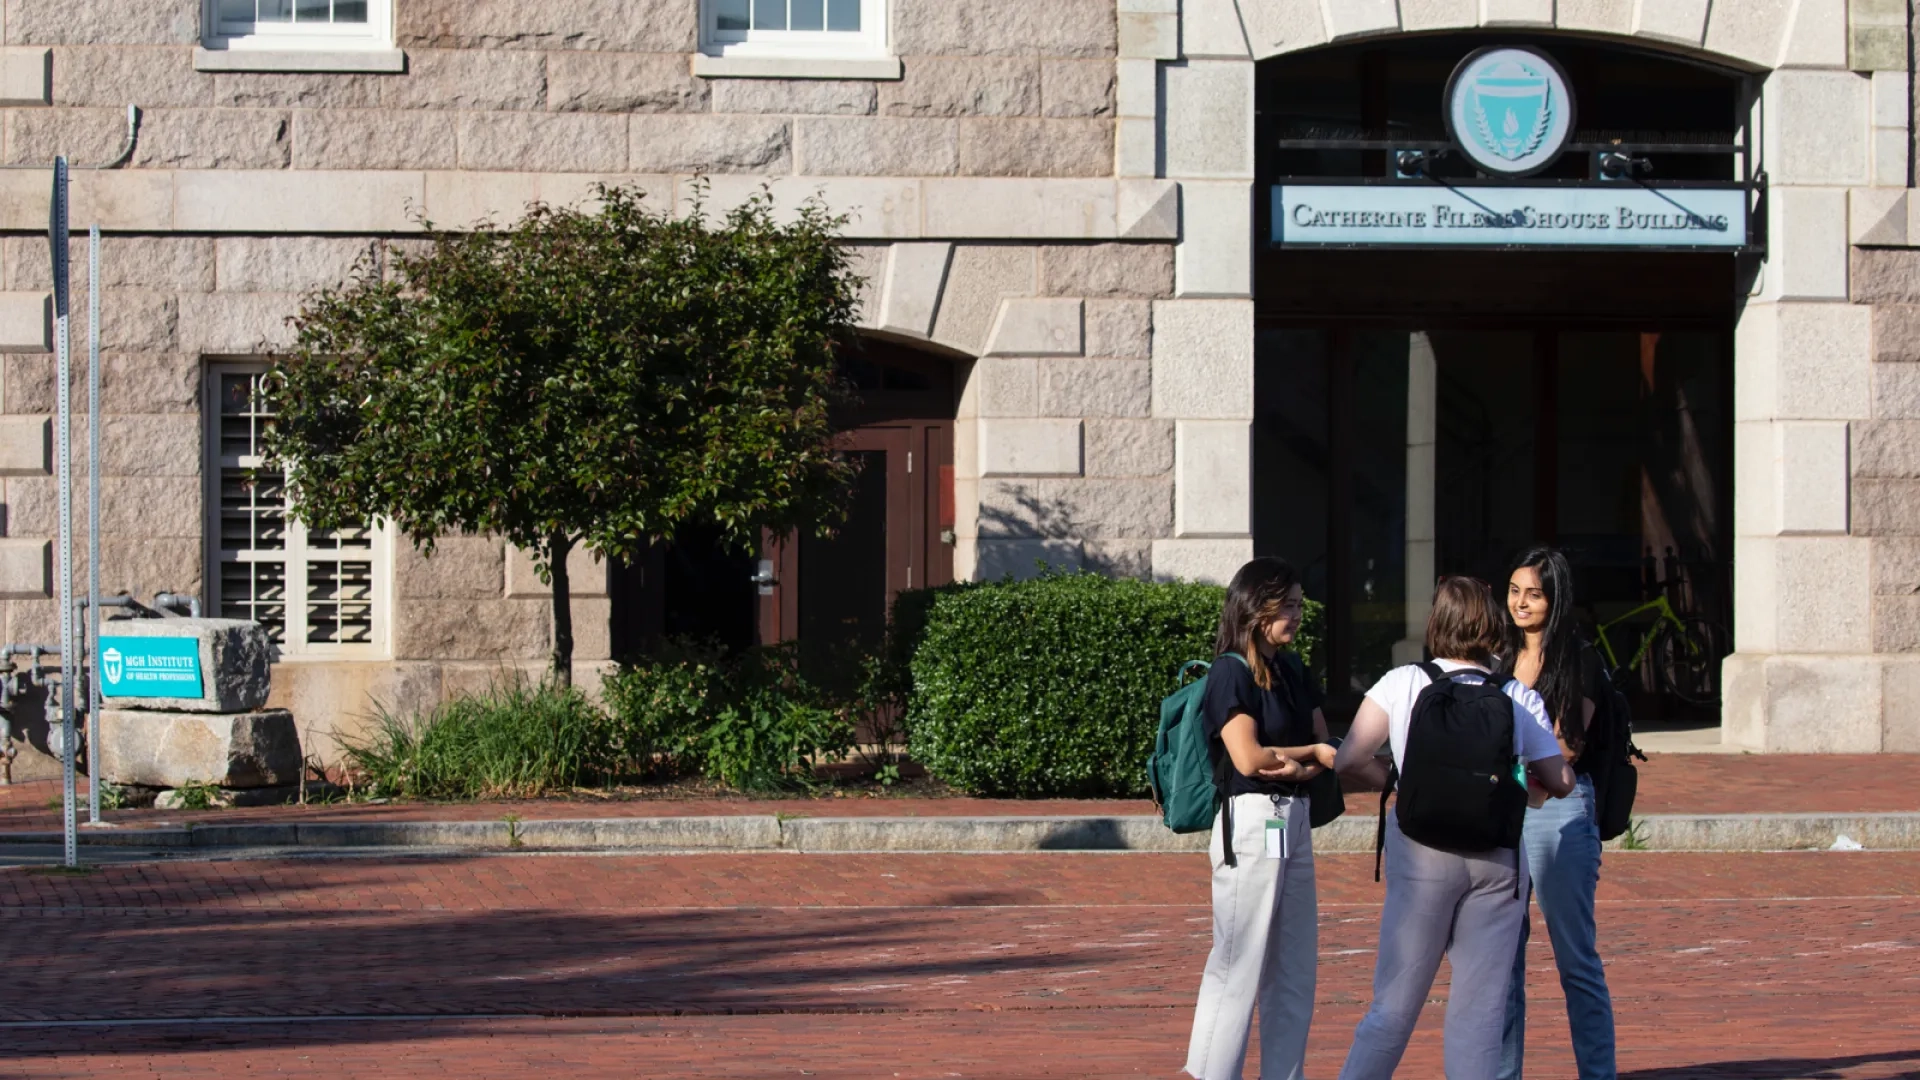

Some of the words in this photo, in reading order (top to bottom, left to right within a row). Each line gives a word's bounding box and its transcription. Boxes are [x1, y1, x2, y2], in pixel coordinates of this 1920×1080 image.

[1292, 203, 1427, 228] CATHERINE
[1522, 205, 1610, 229] SHOUSE
[1615, 206, 1729, 232] BUILDING
[125, 655, 145, 667] MGH
[147, 654, 194, 668] INSTITUTE
